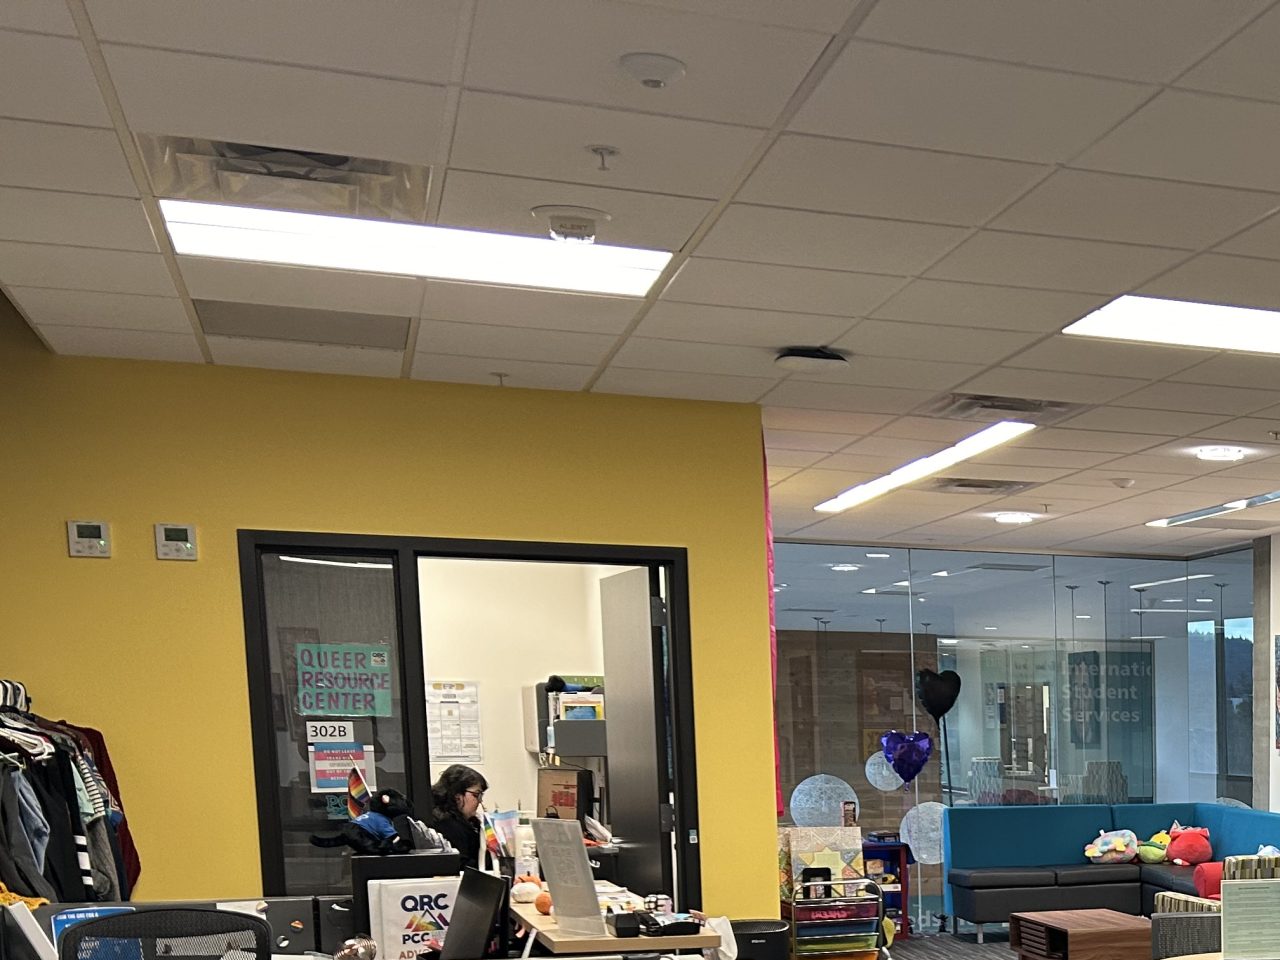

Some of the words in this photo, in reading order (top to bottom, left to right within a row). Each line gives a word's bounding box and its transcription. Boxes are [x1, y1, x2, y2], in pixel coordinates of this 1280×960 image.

[300, 649, 367, 669] QUEER
[301, 671, 391, 691] RESOURCE
[1061, 683, 1139, 700] Student
[302, 692, 376, 711] CENTER
[1062, 707, 1140, 722] Services
[310, 725, 347, 738] 302B
[400, 893, 450, 913] QRC
[402, 932, 430, 945] PCC
